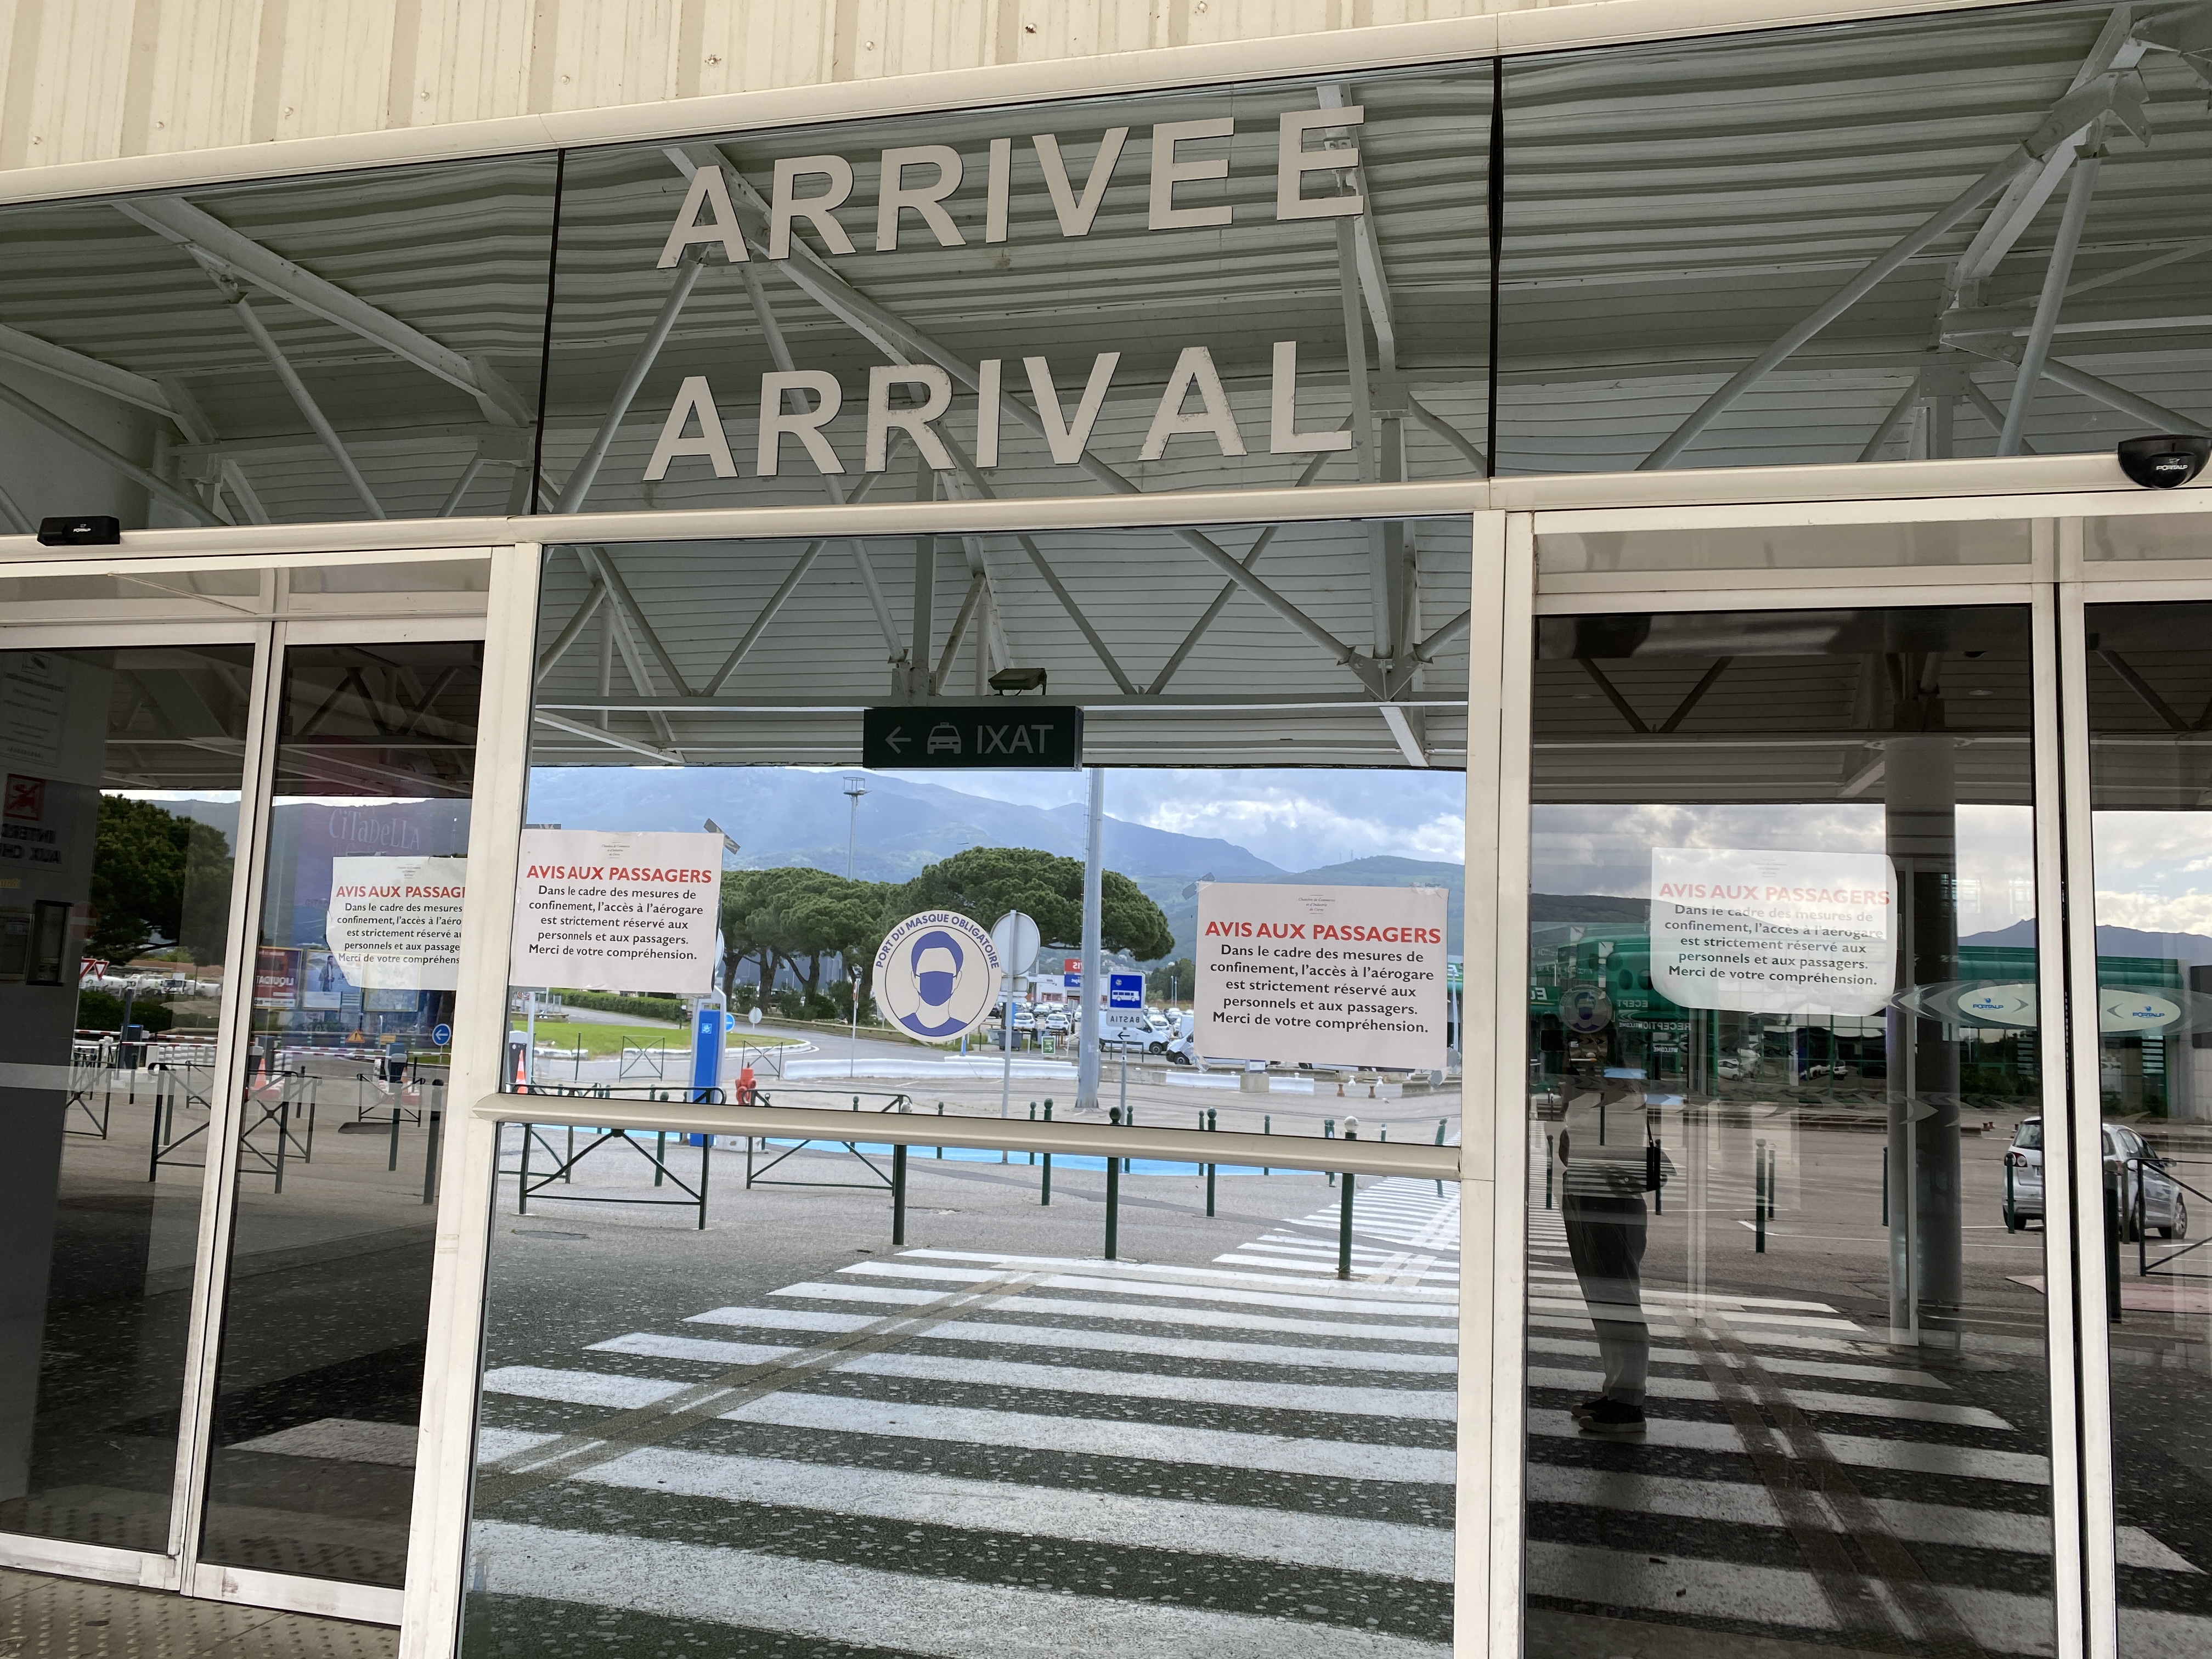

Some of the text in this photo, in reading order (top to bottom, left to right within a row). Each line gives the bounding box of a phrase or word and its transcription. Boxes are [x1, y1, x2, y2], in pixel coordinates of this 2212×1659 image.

[656, 105, 1365, 269] ARRIVEE
[642, 341, 1354, 482] ARRIVAL
[527, 865, 712, 883] AVIS AUX PASSAGERS
[336, 886, 366, 897] AVIS
[368, 886, 401, 898] AUX
[539, 885, 696, 899] Dans le cadre des mesures de
[1659, 883, 1890, 905] AVIS AUX PASSAGERS
[369, 903, 376, 911] le
[529, 900, 703, 917] confinement, l’accès à l’aérogare
[1675, 904, 1873, 922] Dans le cadre des mesures de
[337, 916, 394, 926] confinement,
[397, 916, 425, 924] l’accès
[560, 916, 620, 927] strictement
[623, 918, 664, 928] réservé
[362, 928, 414, 937] strictement
[416, 929, 451, 938] réservé
[538, 931, 592, 941] personnels
[595, 933, 607, 941] et
[633, 936, 688, 946] passagers.
[1205, 922, 1441, 944] AVIS AUX PASSAGERS
[1665, 920, 1883, 940] confinement, l’accès à l’aérogare
[345, 941, 392, 951] personnels
[876, 913, 1000, 969] PORT DU MASQUE OBLIGATOIRE
[1680, 938, 1700, 946] est
[1703, 937, 1782, 949] strictement
[1787, 940, 1837, 952] réservé
[338, 953, 361, 962] Merci
[364, 953, 374, 962] de
[529, 944, 697, 960] Merci de votre compréhension.
[1221, 944, 1423, 962] Dans le cadre des mesures de
[1679, 953, 1750, 963] personnels
[1754, 956, 1768, 964] et
[1800, 959, 1867, 970] passagers.
[1210, 962, 1298, 977] confinement,
[1302, 964, 1346, 977] l’accès
[1351, 967, 1359, 977] à
[1363, 967, 1434, 982] l’aérogare
[1669, 966, 1877, 985] Merci de votre compréhension.
[1226, 980, 1416, 997] est strictement réservé aux
[1224, 998, 1417, 1017] personnels et aux passagers.
[1213, 1012, 1428, 1032] Merci de votre compréhension.
